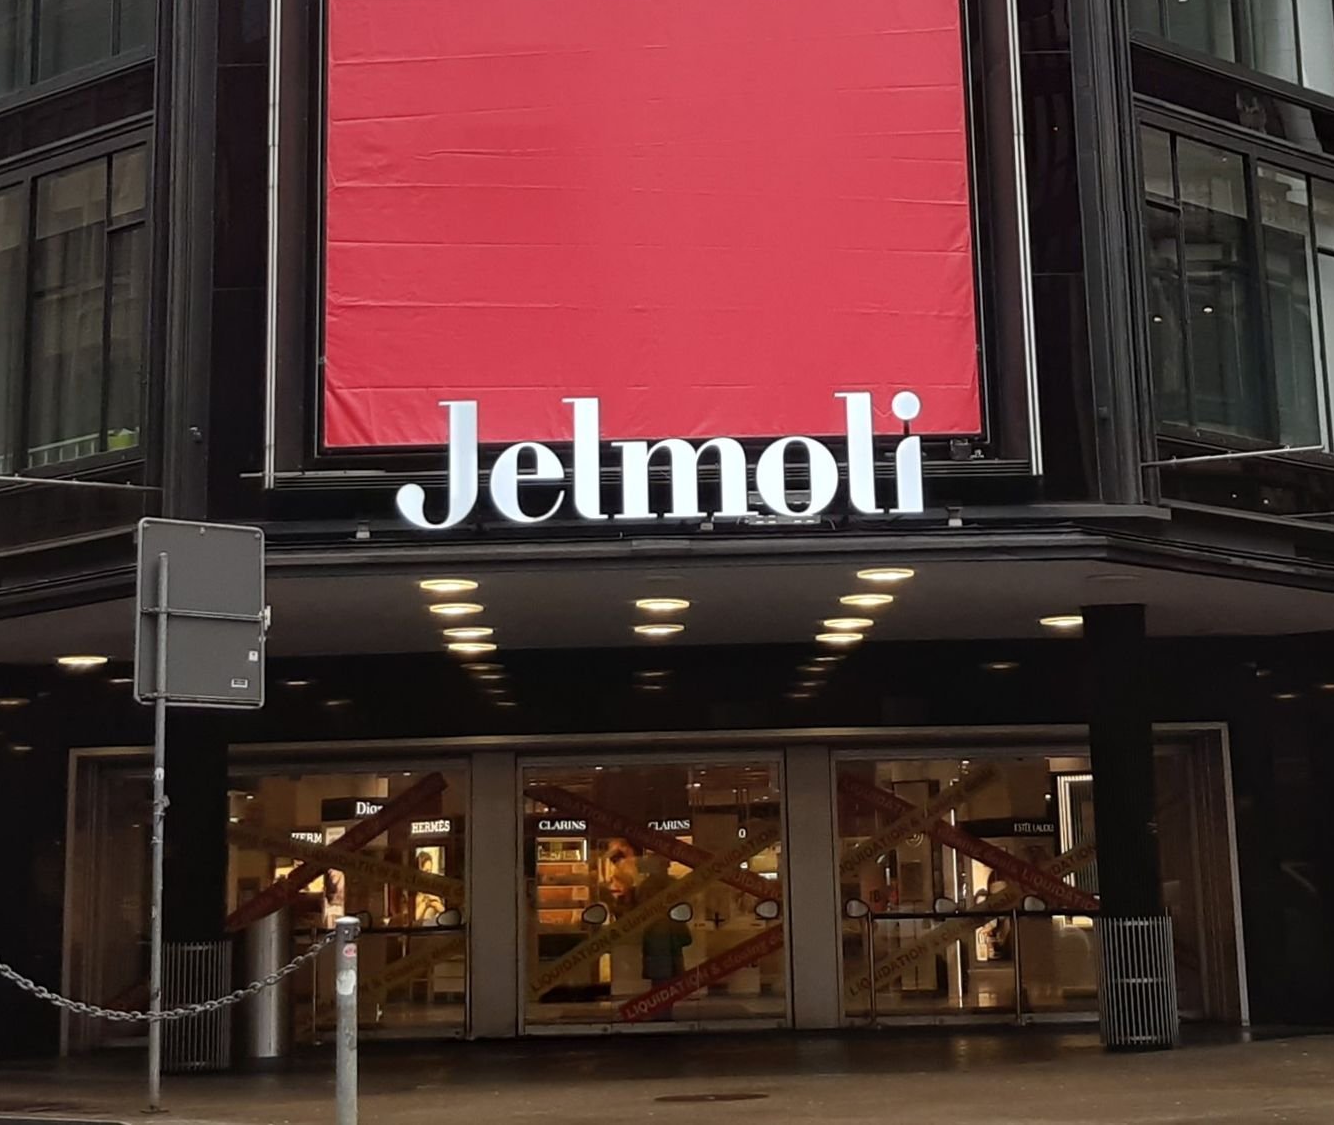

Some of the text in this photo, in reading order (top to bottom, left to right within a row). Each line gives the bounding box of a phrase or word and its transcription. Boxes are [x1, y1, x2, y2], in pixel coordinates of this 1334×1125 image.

[396, 391, 925, 529] Jelmoli
[538, 820, 587, 830] CLARINS
[648, 820, 690, 830] CLARINS
[625, 968, 711, 1019] LIQUIDATION
